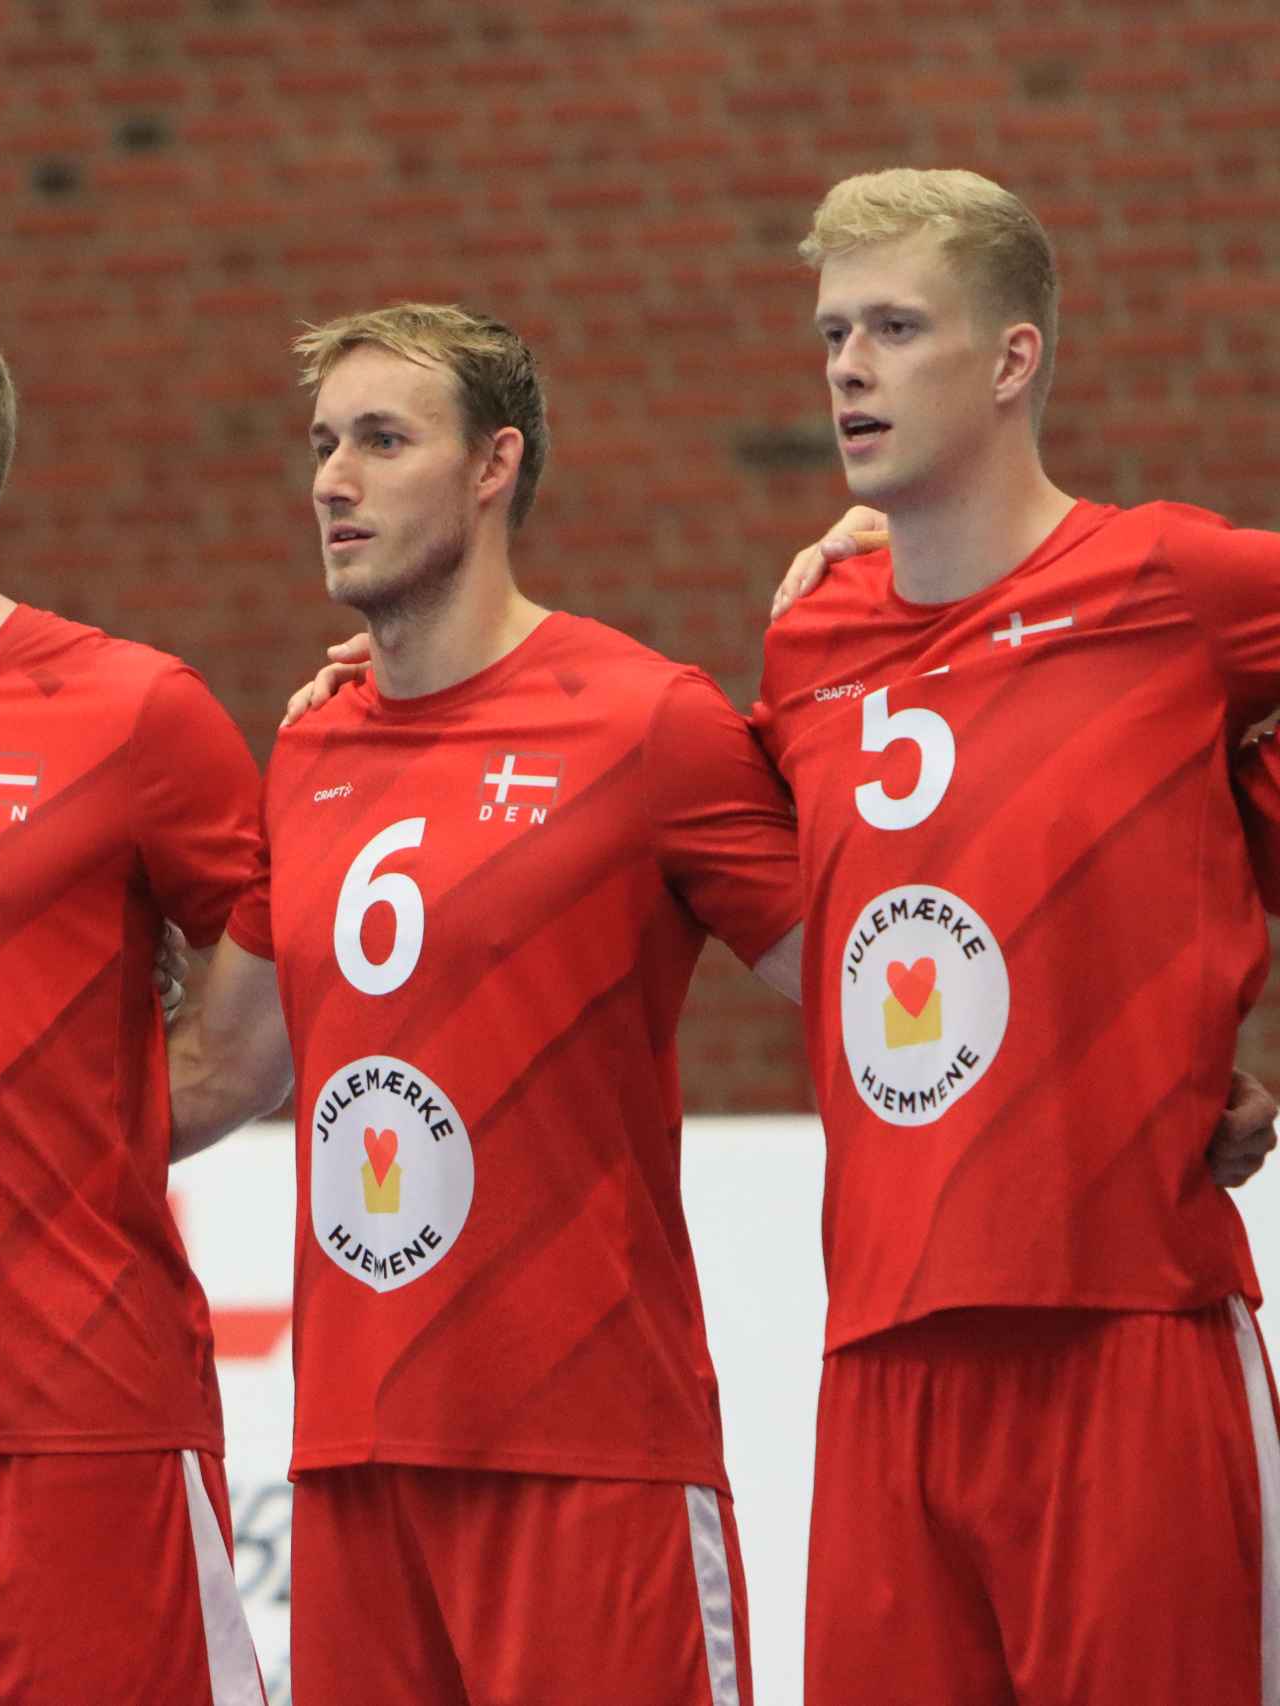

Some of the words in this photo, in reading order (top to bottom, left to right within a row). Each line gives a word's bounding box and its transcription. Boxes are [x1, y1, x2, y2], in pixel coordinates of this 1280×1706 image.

[814, 684, 855, 702] CRAFT
[855, 665, 955, 831] 5
[313, 786, 346, 802] CRAFT
[334, 817, 427, 996] 6
[846, 898, 986, 983] JULEMÆRKE
[317, 1068, 454, 1143] JULEMÆRKE
[861, 1045, 979, 1113] HJEMMENE
